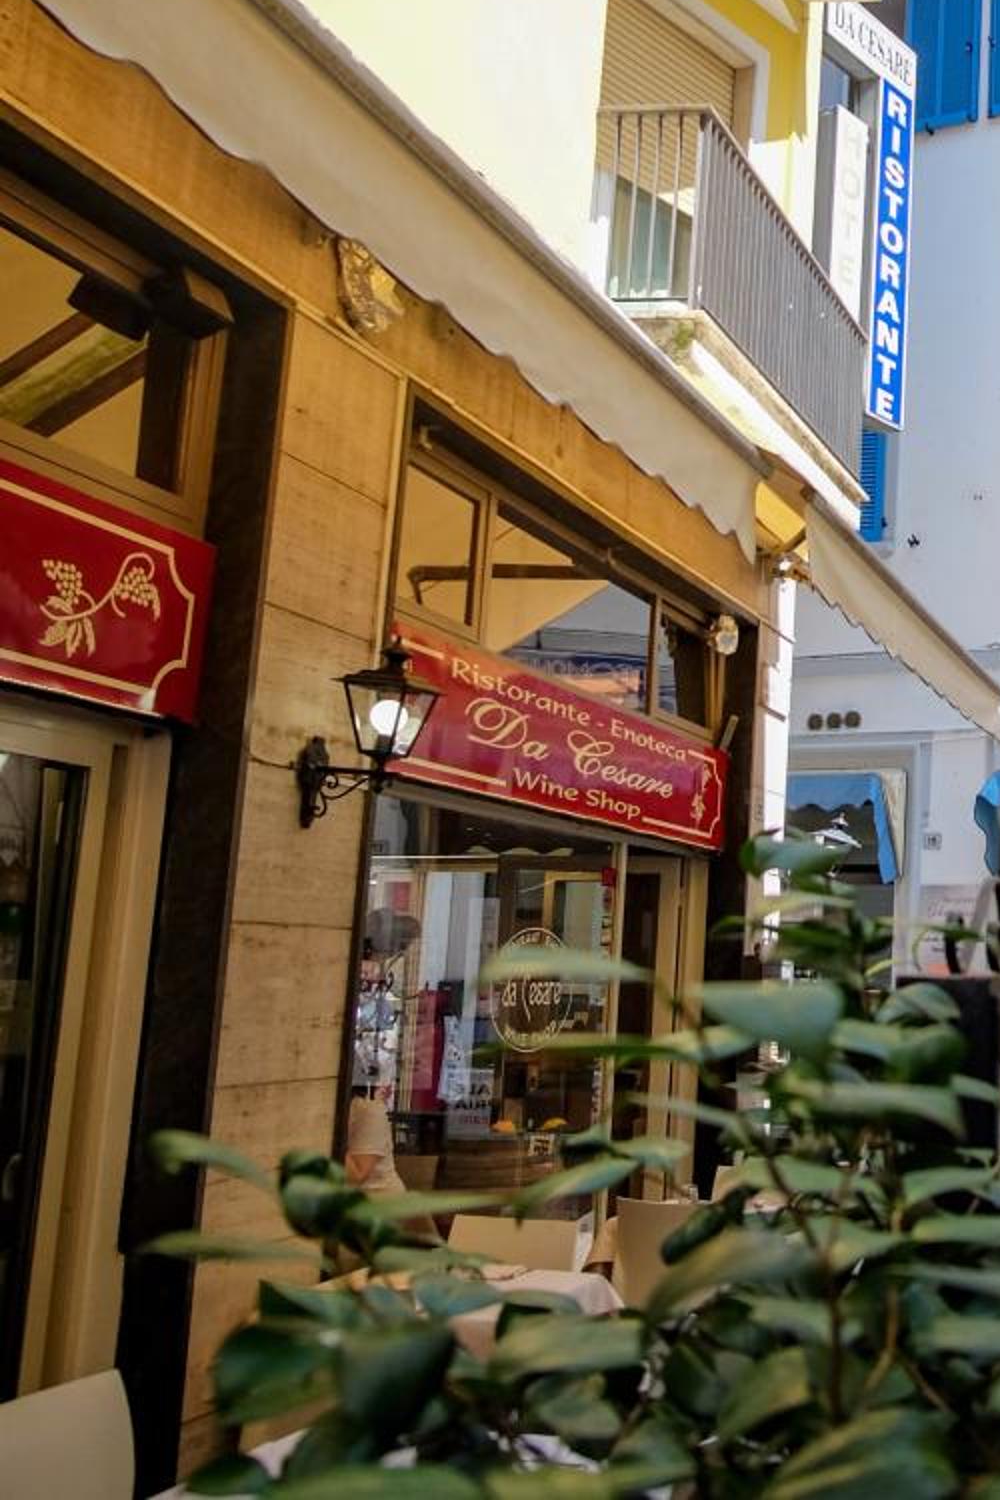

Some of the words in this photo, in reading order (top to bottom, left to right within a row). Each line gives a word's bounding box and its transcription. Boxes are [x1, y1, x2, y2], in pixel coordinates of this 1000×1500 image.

[857, 20, 914, 88] CESARE
[875, 89, 908, 421] RISTORANTE
[451, 657, 592, 727] Ristorante
[610, 718, 688, 762] Enoteca
[464, 696, 550, 762] Da
[566, 729, 674, 799] Cesare
[511, 767, 580, 802] Wine
[585, 788, 642, 820] Shop
